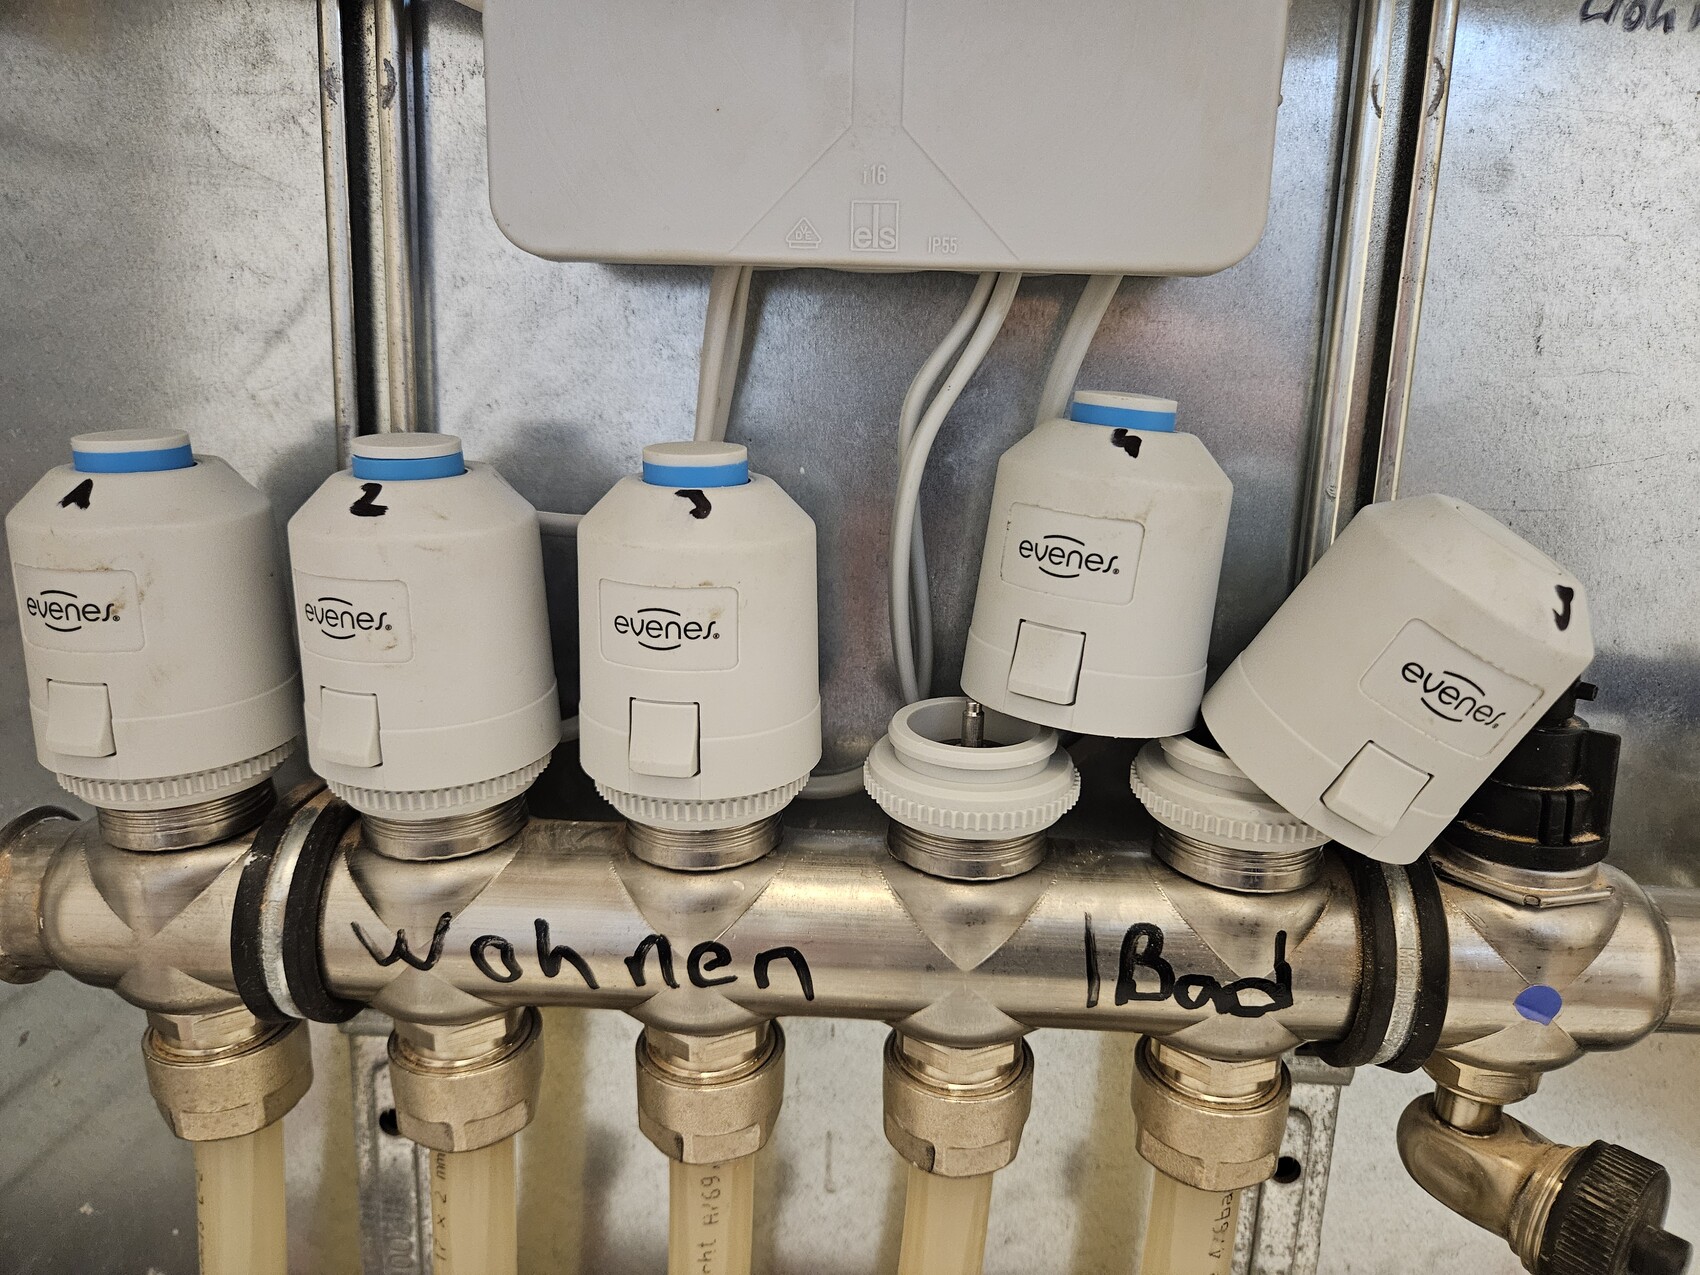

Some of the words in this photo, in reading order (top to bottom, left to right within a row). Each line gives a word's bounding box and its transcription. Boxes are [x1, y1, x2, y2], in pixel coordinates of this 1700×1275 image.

[928, 236, 958, 254] IP55
[350, 483, 389, 517] 2
[1115, 922, 1294, 1018] Bad
